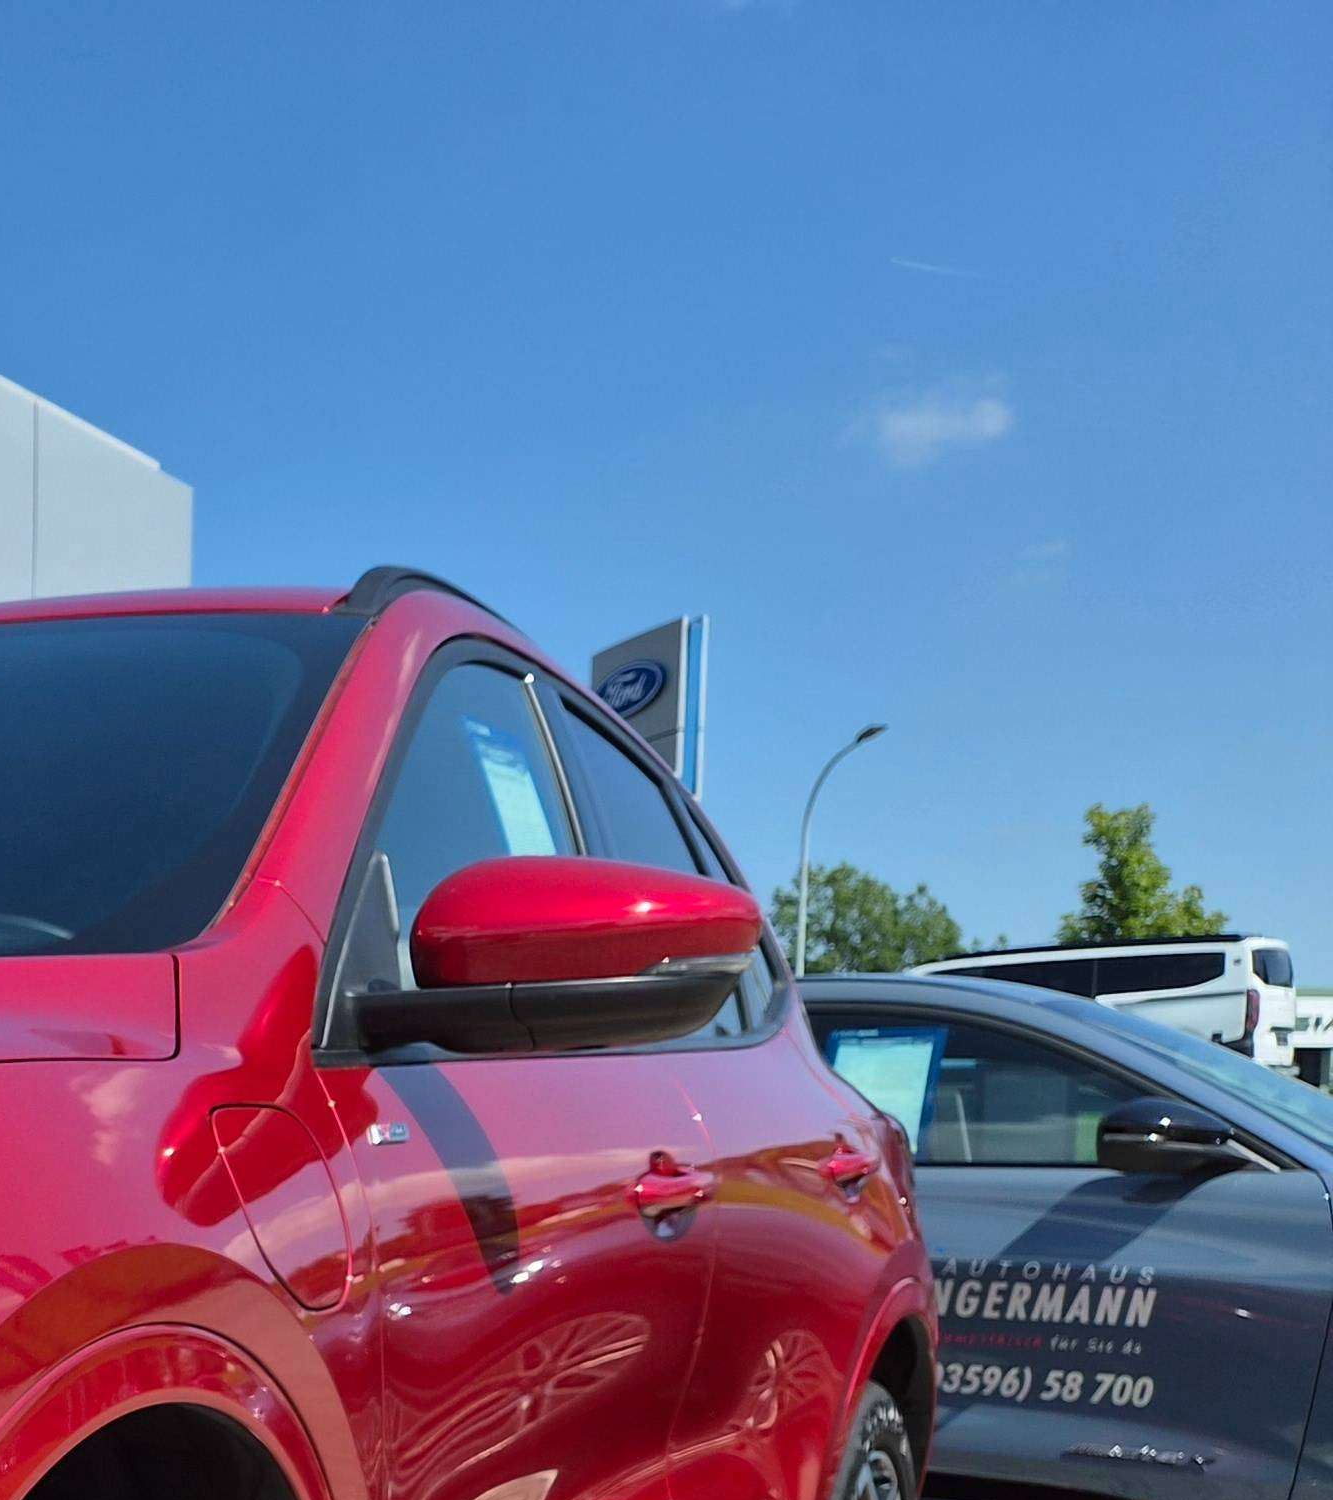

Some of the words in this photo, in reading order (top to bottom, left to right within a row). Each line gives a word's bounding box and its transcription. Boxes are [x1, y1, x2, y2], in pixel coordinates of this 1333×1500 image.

[940, 1258, 1157, 1286] AUTOHAUS
[1040, 1370, 1084, 1402] 58
[1090, 1373, 1154, 1408] 700
